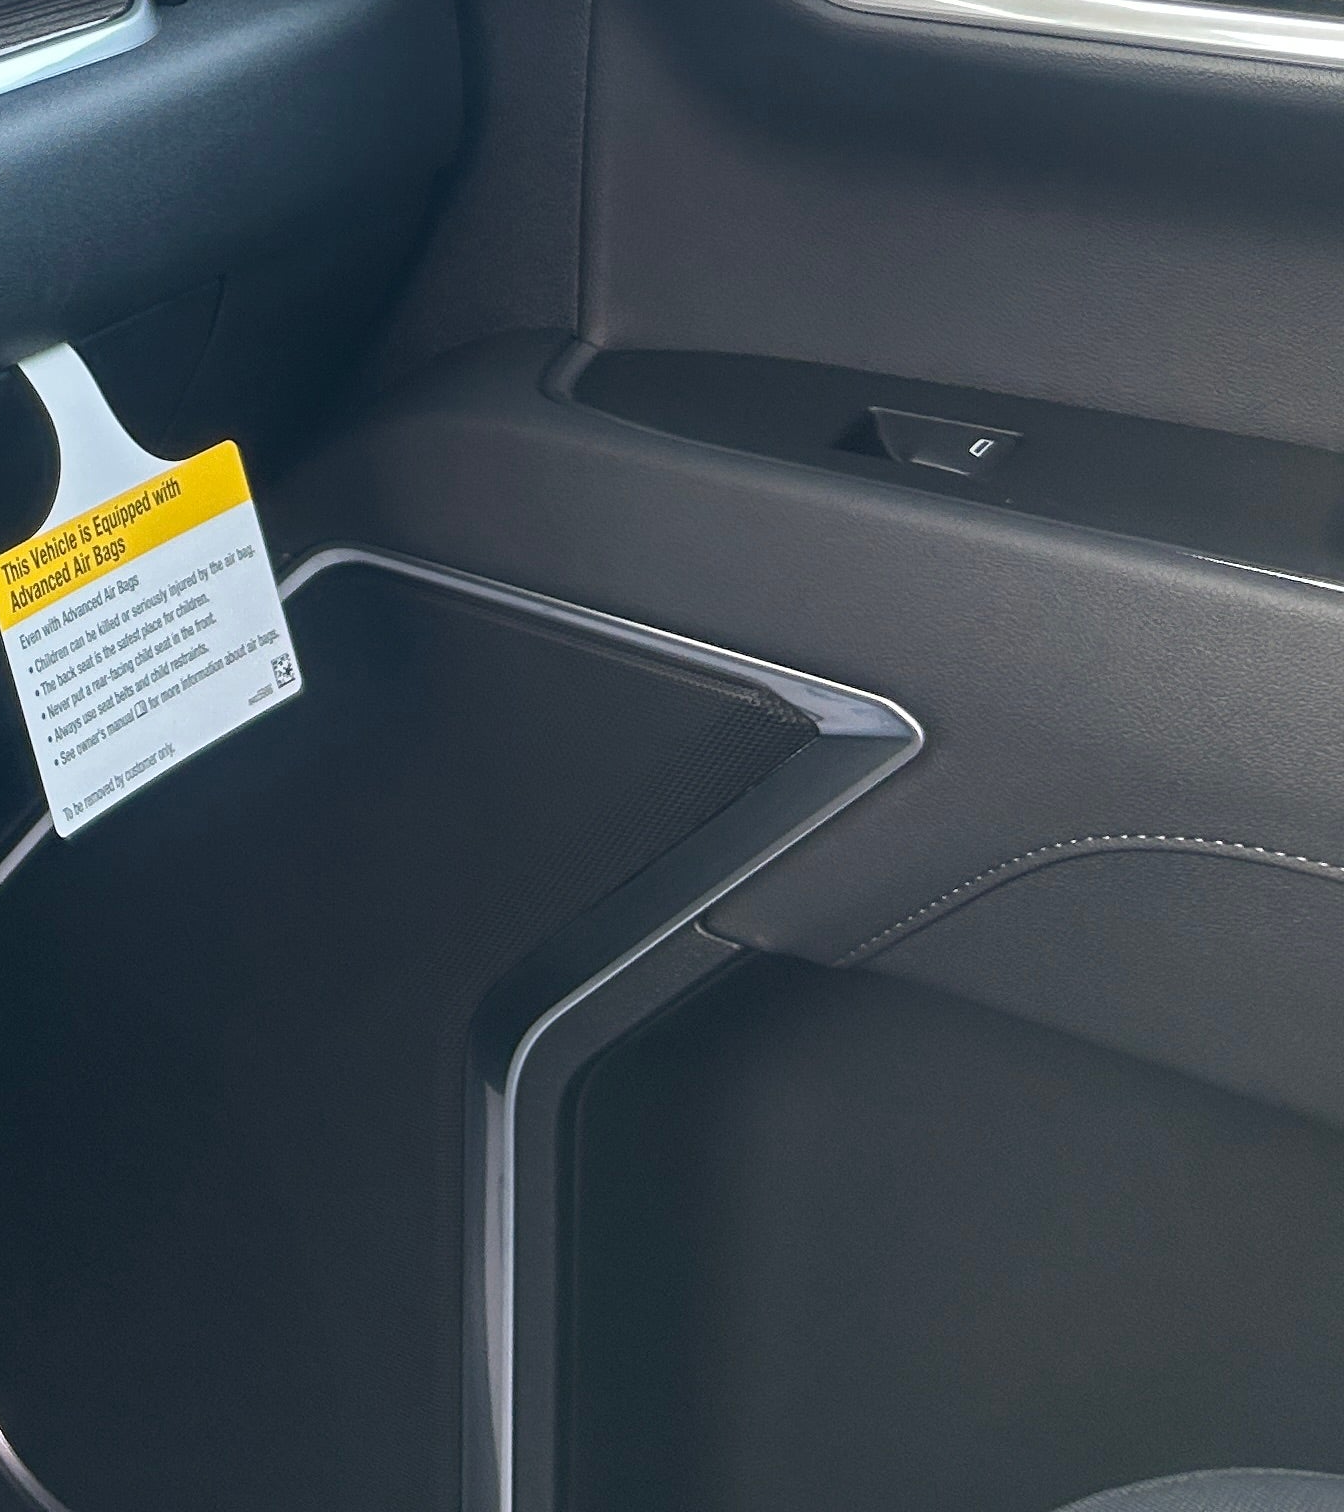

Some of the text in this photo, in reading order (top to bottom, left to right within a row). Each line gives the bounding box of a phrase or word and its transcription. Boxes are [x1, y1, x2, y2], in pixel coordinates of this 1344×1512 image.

[1, 478, 181, 584] This Vehicle is Equipped with
[11, 538, 125, 613] Advanced Air Bags
[19, 575, 139, 649] Even with Advanced Air Bags
[35, 646, 69, 673] Children
[70, 636, 85, 652] can
[85, 630, 97, 642] be
[97, 613, 120, 636] killed
[121, 610, 130, 623] or
[132, 589, 167, 617] seriously
[168, 571, 197, 597] injured
[197, 568, 208, 581] by
[209, 560, 223, 574] the
[224, 553, 235, 567] air
[40, 680, 56, 695] The
[56, 666, 77, 686] back
[77, 655, 95, 674] seat
[94, 651, 103, 664] is
[102, 644, 116, 659] the
[117, 628, 141, 651] safest
[141, 618, 163, 640] place
[163, 610, 174, 625] for
[47, 697, 70, 719] Never
[71, 687, 85, 707] put
[85, 685, 92, 696] a
[92, 660, 135, 691] rear-facing
[134, 645, 154, 666] child
[154, 636, 172, 655] seat
[171, 632, 181, 645] in
[180, 626, 194, 640] the
[54, 718, 82, 742] Always
[82, 709, 97, 724] use
[97, 695, 115, 715] seat
[114, 686, 135, 704] belts
[135, 674, 150, 692] and
[150, 661, 170, 683] child
[60, 748, 76, 765] See
[76, 728, 107, 755] owner's
[148, 695, 160, 709] for
[161, 684, 181, 703] more
[224, 644, 247, 665] about
[246, 638, 257, 653] air
[62, 807, 73, 821] To
[72, 802, 84, 815] be
[114, 774, 125, 789] by
